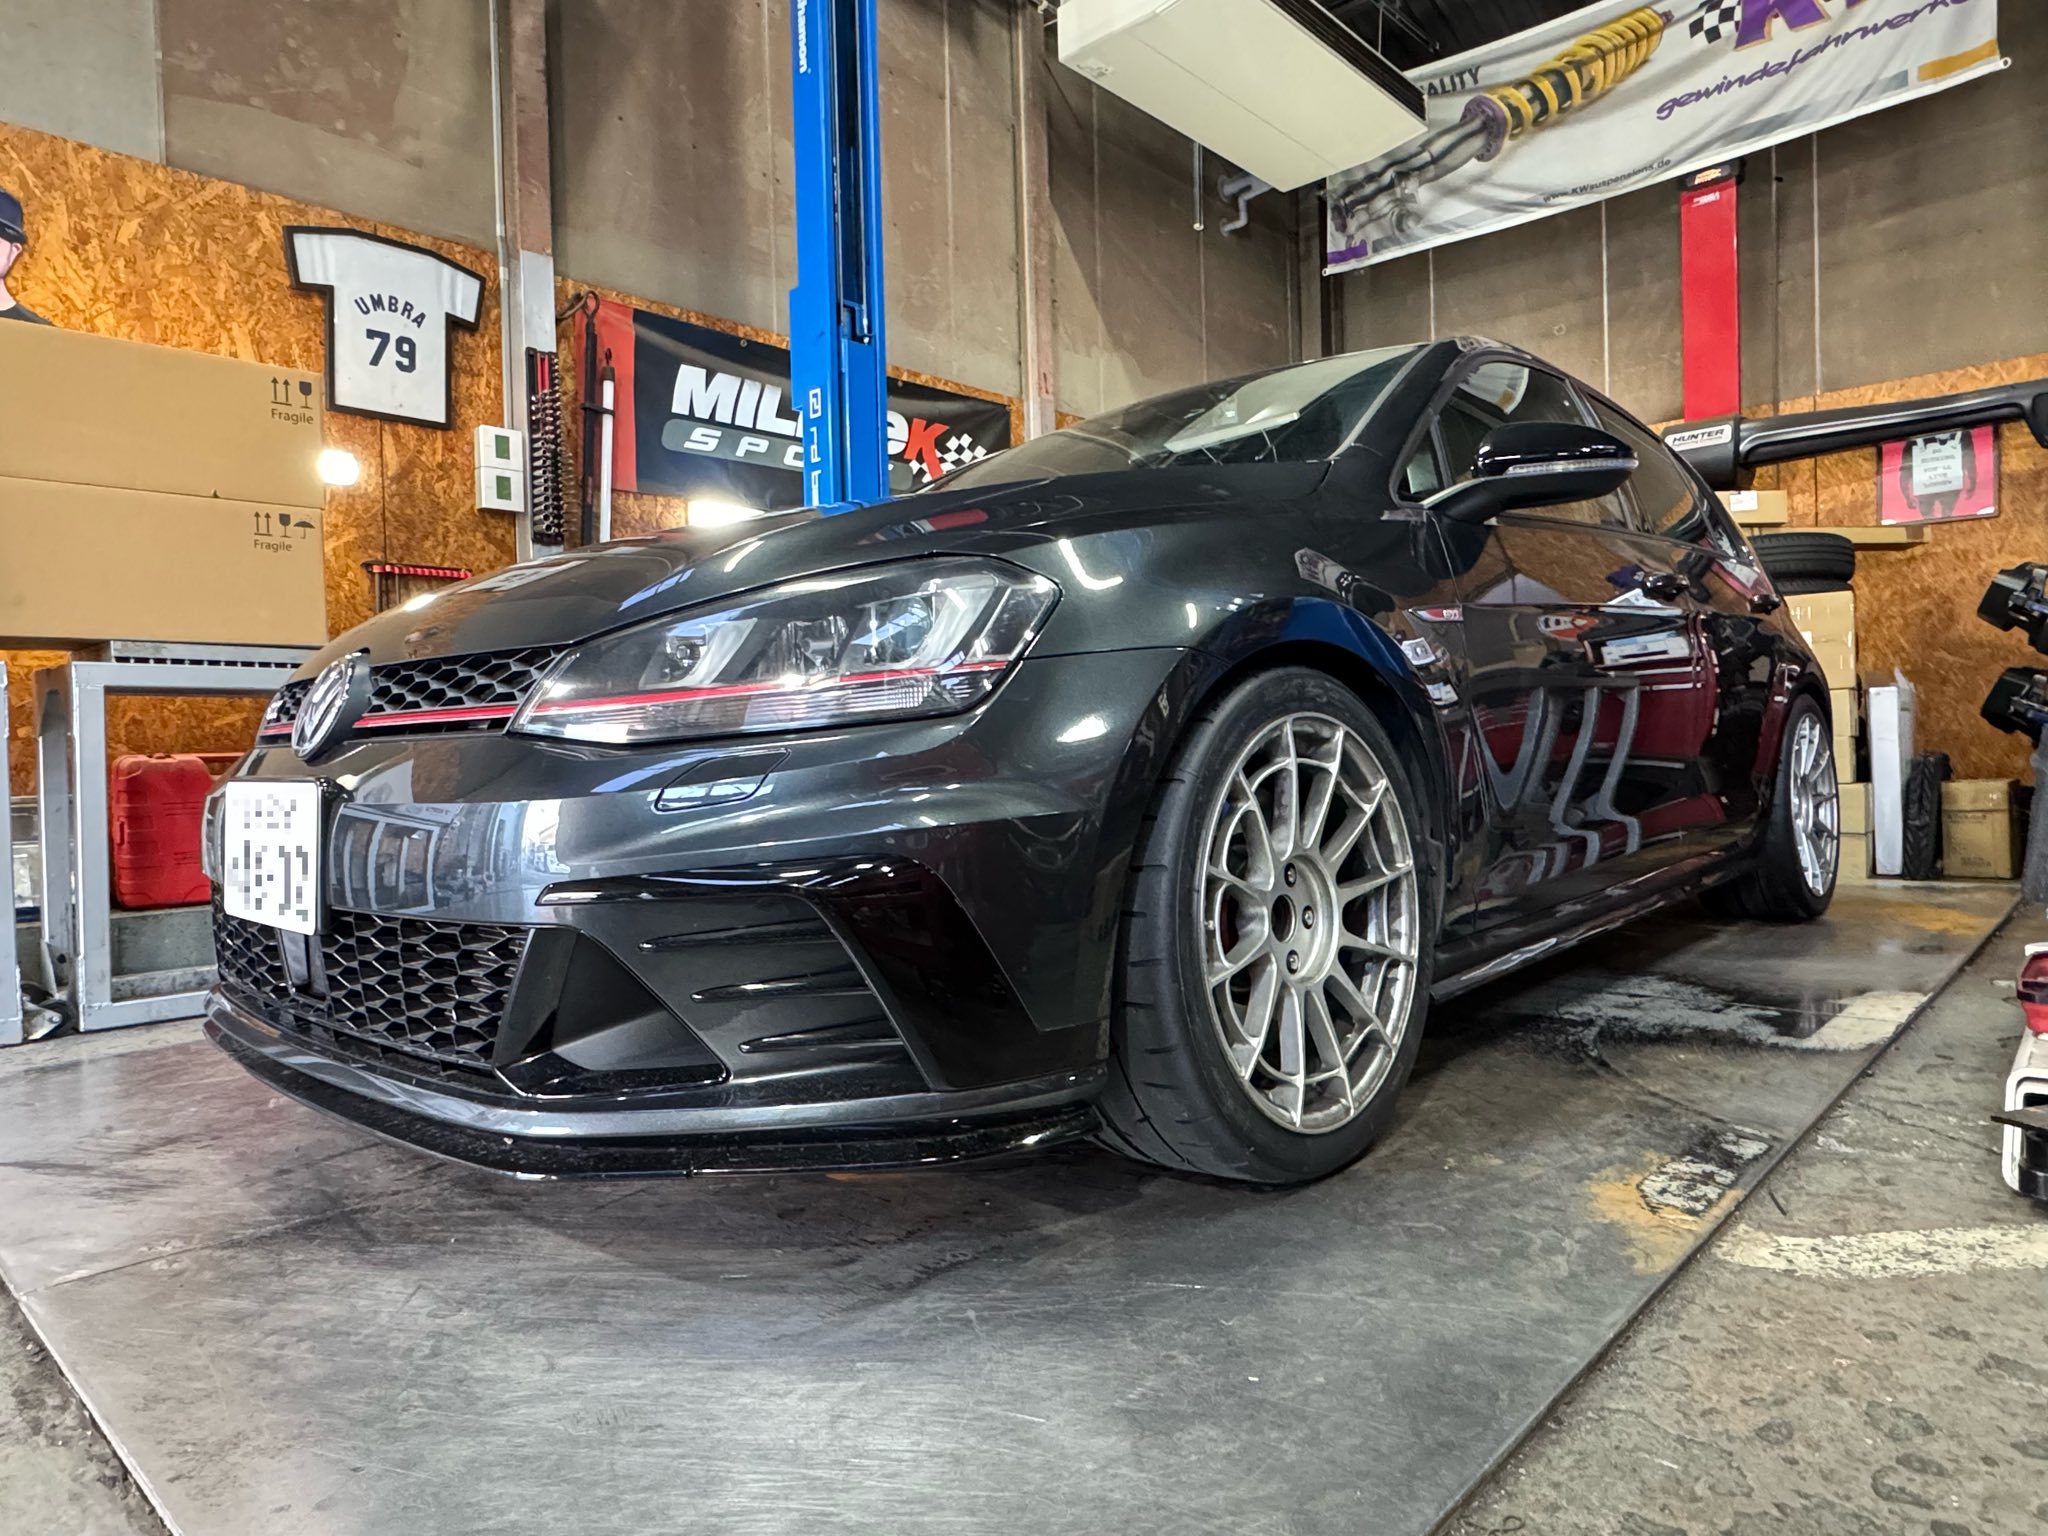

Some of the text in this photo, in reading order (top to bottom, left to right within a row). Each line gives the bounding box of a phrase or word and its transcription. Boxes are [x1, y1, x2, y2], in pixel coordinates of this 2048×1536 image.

[354, 293, 426, 328] UMBRA
[366, 328, 416, 374] 79
[271, 408, 314, 425] Fragile
[1672, 428, 1725, 444] HUNTER
[253, 539, 293, 553] Fragile
